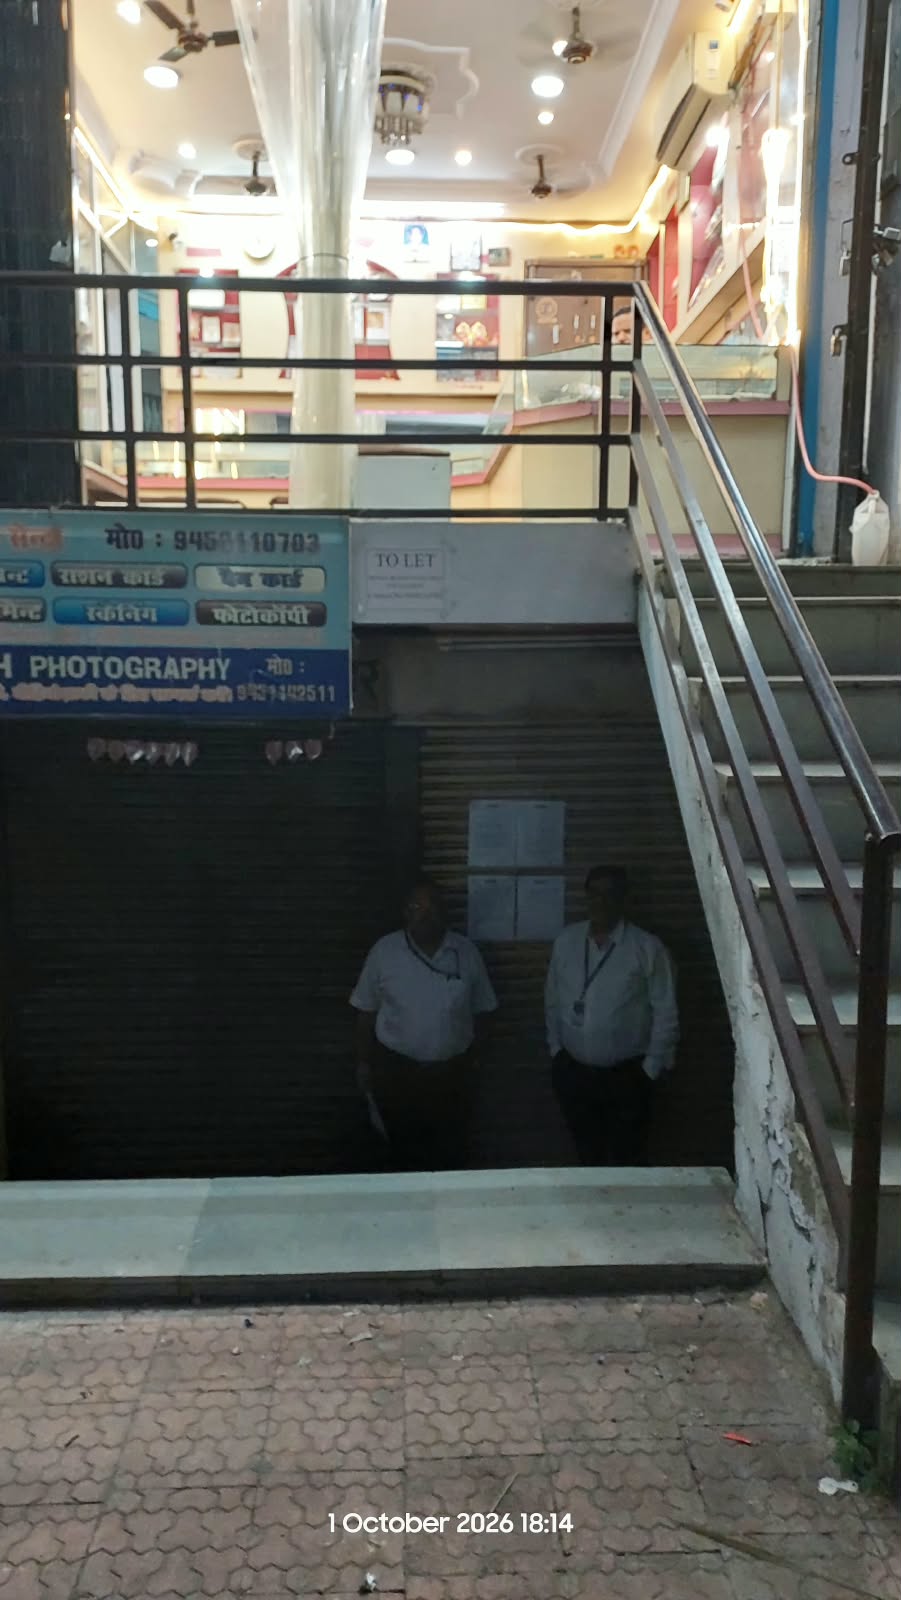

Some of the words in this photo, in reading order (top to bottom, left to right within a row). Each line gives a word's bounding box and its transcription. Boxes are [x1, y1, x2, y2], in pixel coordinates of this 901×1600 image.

[374, 552, 400, 568] TO
[403, 552, 436, 568] LET
[258, 567, 304, 588] कार्ड
[29, 655, 231, 681] PHOTOGRAPHY
